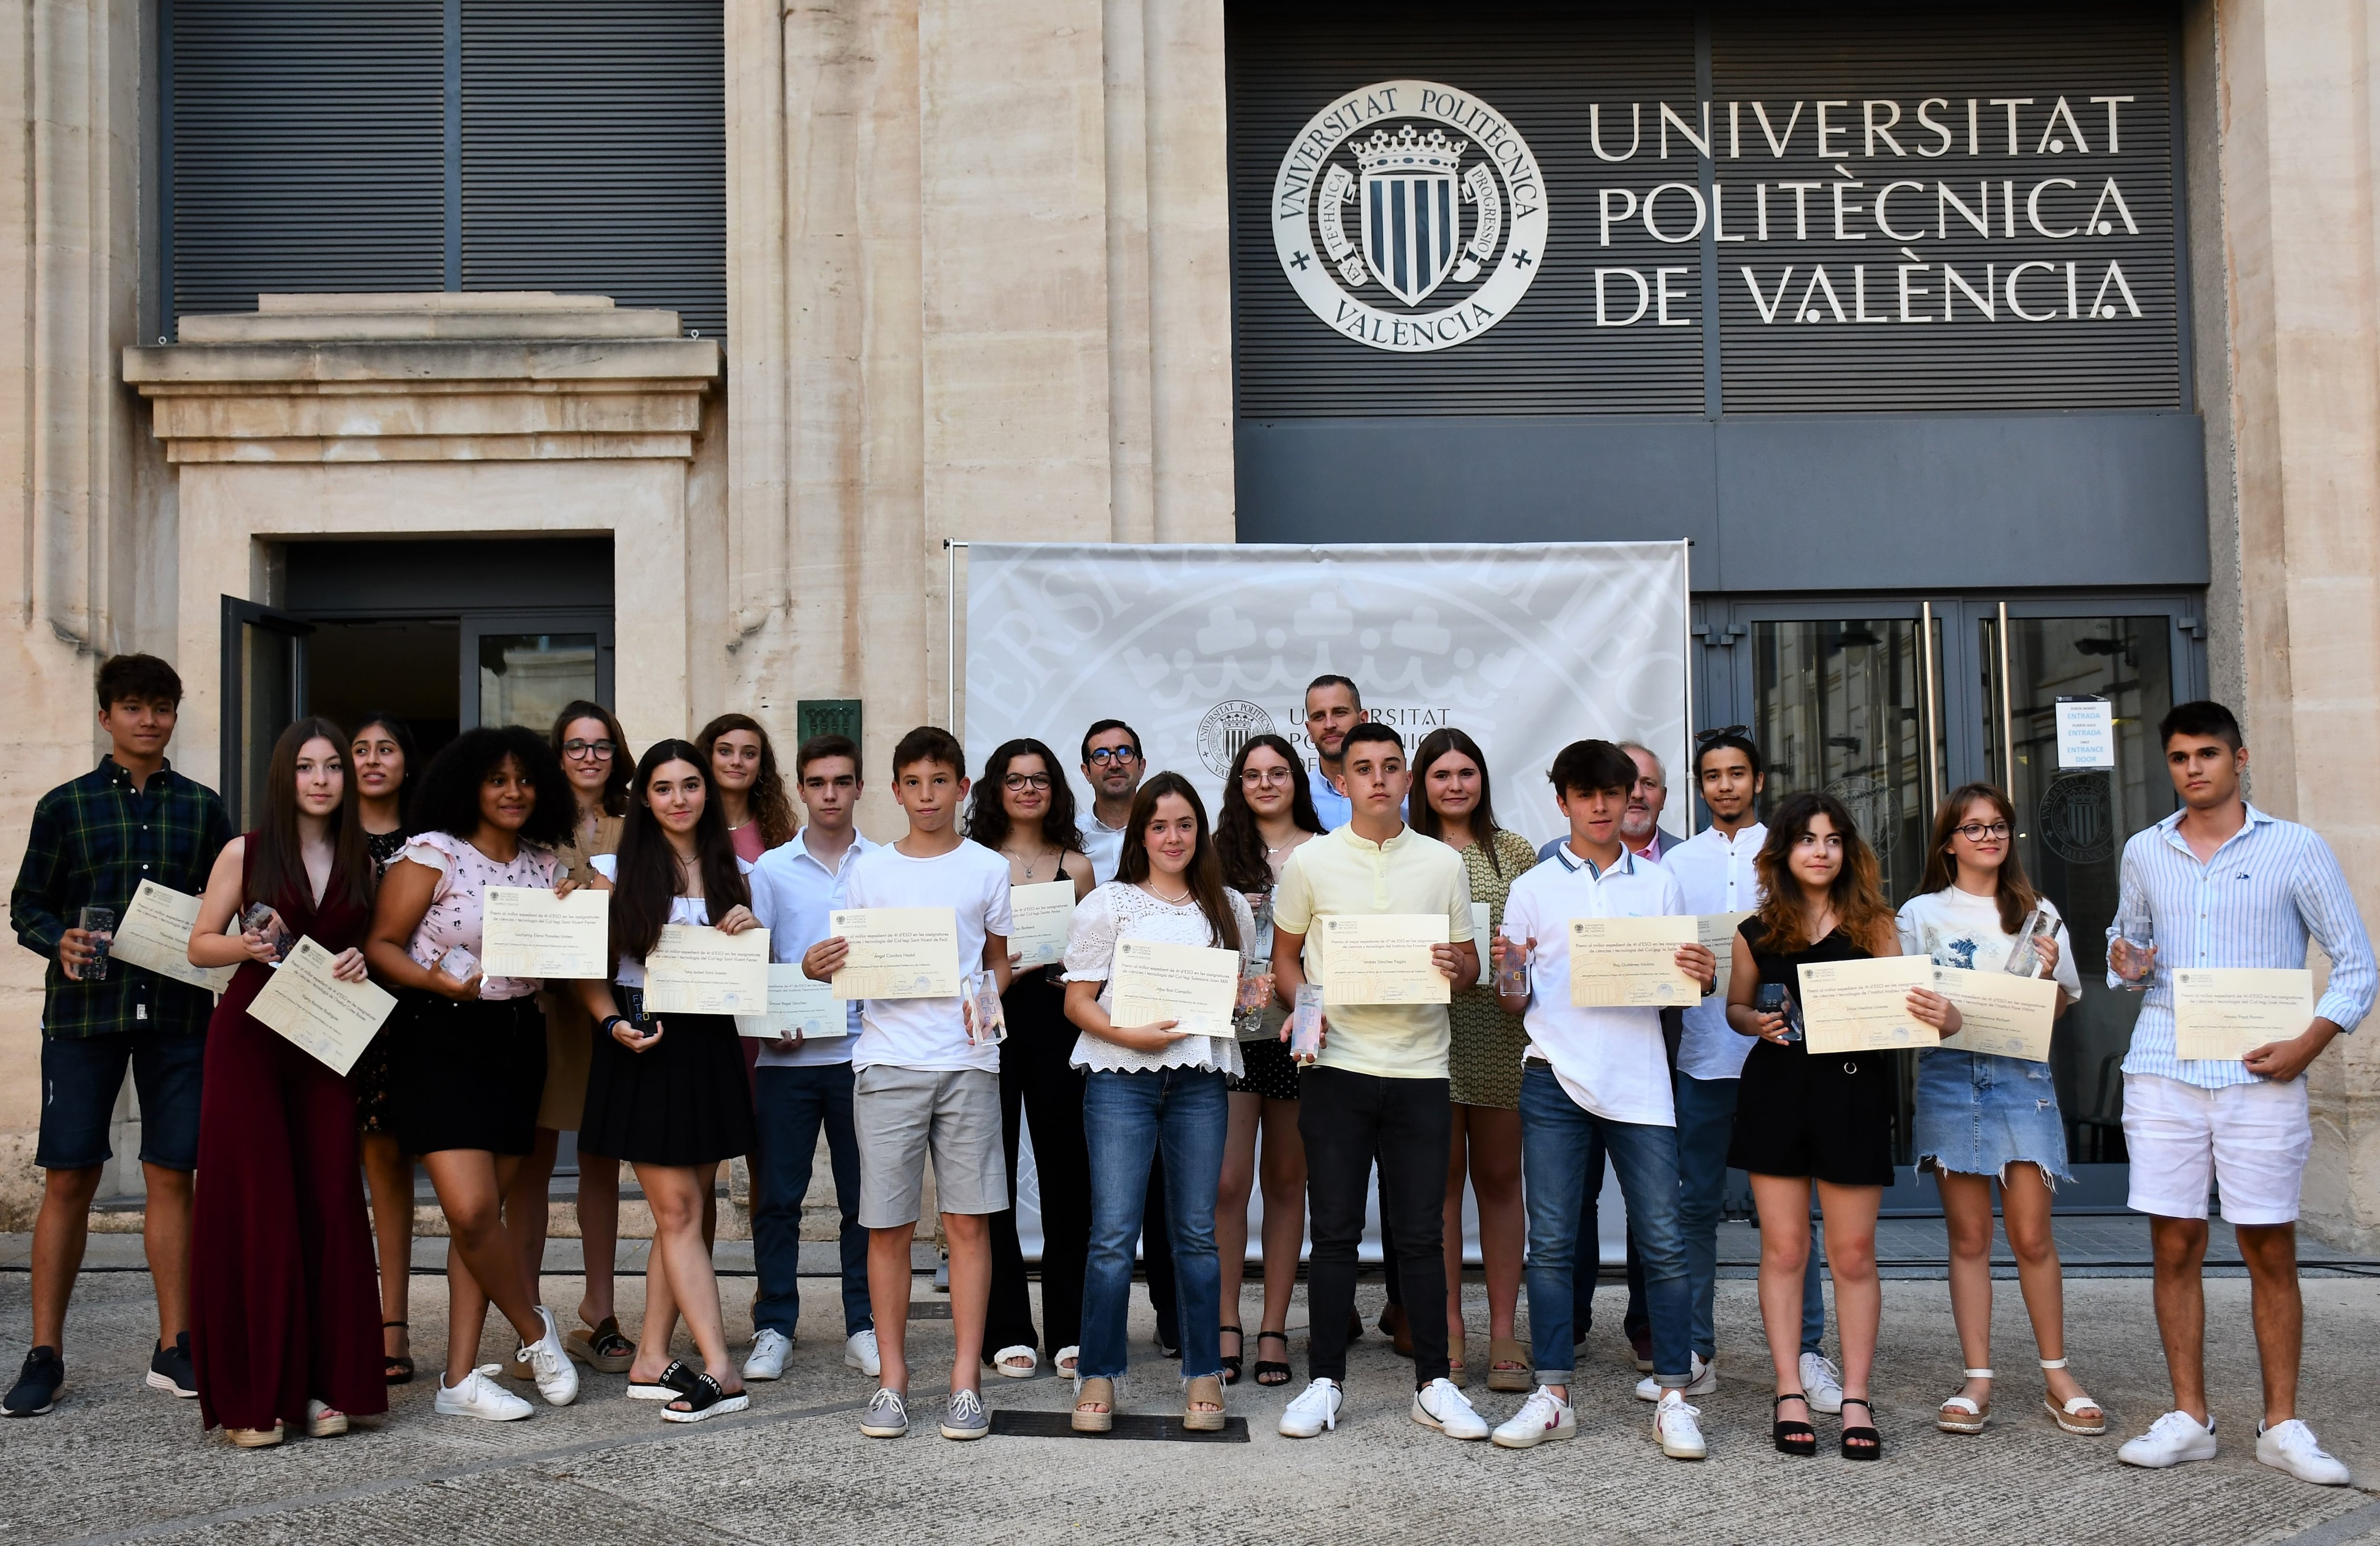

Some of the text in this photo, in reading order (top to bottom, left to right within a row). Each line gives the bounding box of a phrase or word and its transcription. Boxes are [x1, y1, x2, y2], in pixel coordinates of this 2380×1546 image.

[1589, 96, 2134, 162] UNIVERSITAT
[1420, 89, 1539, 220] POLITÈCNICA
[1472, 168, 1497, 254] PROGRESSIO
[1600, 163, 2139, 247] POLITÈCNICA
[1344, 264, 1360, 281] EX
[1596, 249, 2142, 327] DE VALÈNCIA
[1333, 298, 1495, 346] VALÈNCIA
[1290, 708, 1450, 725] URSITAT
[633, 994, 646, 1002] FU
[981, 997, 994, 1005] FU
[635, 1002, 648, 1012] TU
[983, 1006, 996, 1015] TU
[635, 1012, 649, 1021] RO
